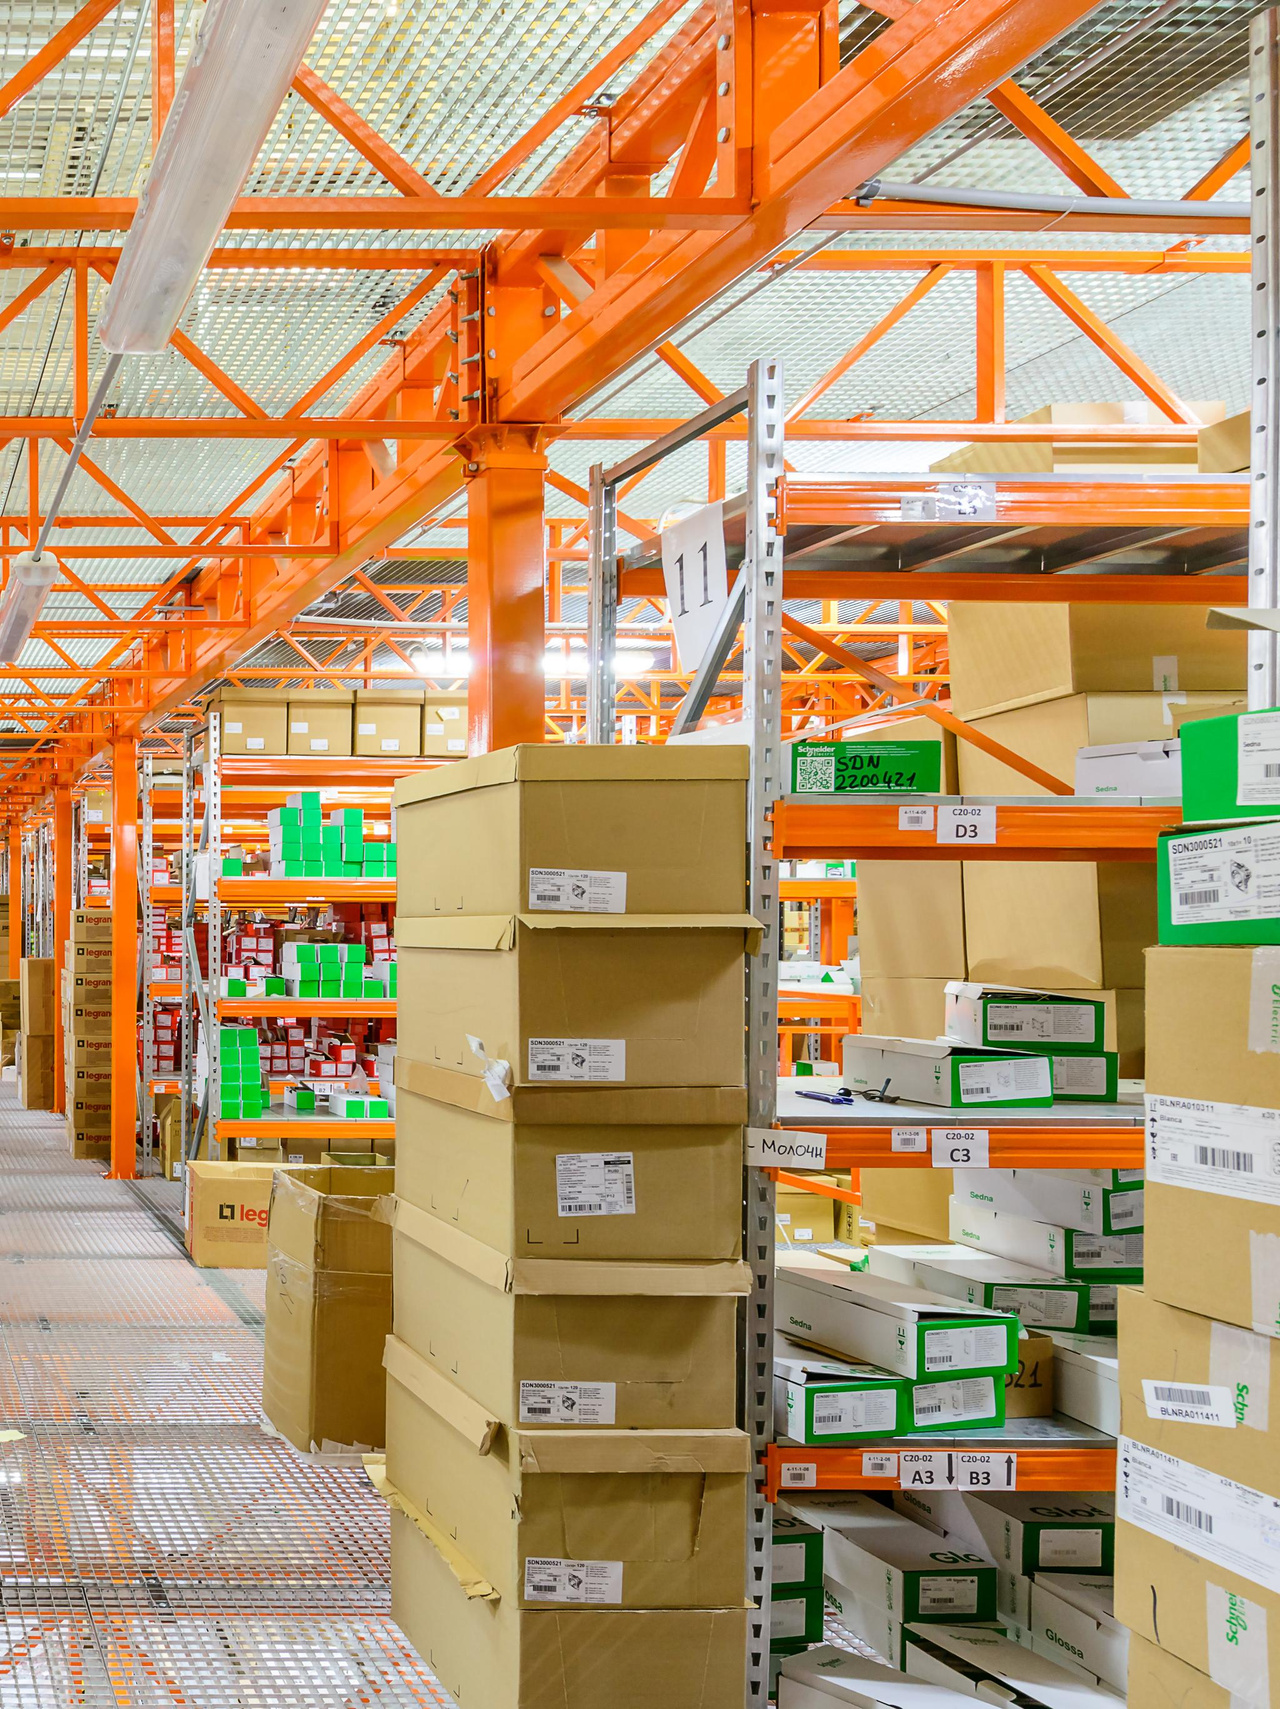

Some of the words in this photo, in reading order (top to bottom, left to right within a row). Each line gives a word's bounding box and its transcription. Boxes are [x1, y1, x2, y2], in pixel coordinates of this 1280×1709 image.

[674, 541, 713, 617] 11
[797, 746, 836, 759] Schneider
[836, 755, 881, 772] SDN
[952, 808, 982, 816] C20-02
[955, 824, 979, 839] D3
[1171, 837, 1223, 855] SDN3000521
[1243, 836, 1253, 845] 10
[530, 869, 565, 877] SDN3000521
[86, 915, 112, 925] legran
[86, 948, 112, 958] legran
[85, 978, 112, 988] legran
[85, 1009, 112, 1019] legran
[86, 1039, 112, 1050] legran
[86, 1071, 112, 1081] legran
[85, 1102, 112, 1112] legran
[86, 1132, 112, 1143] legran
[945, 1132, 975, 1141] C20-02
[949, 1148, 972, 1163] C3
[969, 1190, 994, 1203] Sedna
[239, 1203, 268, 1228] leg
[961, 1228, 980, 1241] Sedna
[789, 1316, 812, 1331] Sedna
[1233, 1381, 1249, 1425] Schn
[1160, 1406, 1220, 1422] BLNRA011411
[903, 1454, 933, 1463] C20-02
[960, 1455, 991, 1464] C20-02
[911, 1469, 935, 1485] A3
[969, 1470, 991, 1486] B3
[527, 1559, 562, 1567] SDN3000521
[824, 1590, 843, 1614] ossa
[1045, 1628, 1085, 1660] Glossa
